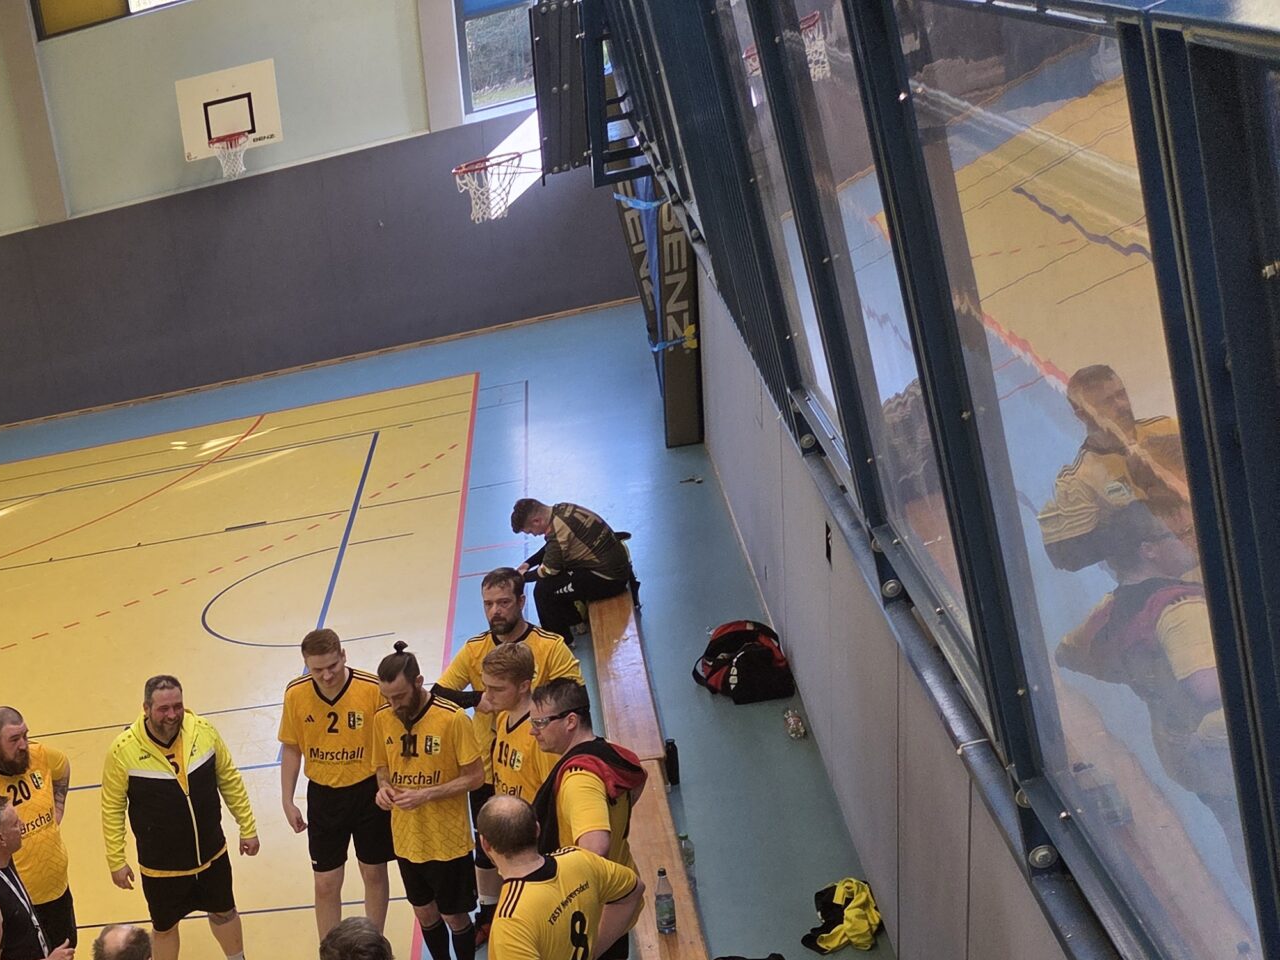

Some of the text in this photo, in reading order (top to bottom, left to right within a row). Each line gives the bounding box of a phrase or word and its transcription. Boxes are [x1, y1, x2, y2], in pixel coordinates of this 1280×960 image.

[327, 711, 339, 733] 2
[309, 746, 365, 761] Marschall
[497, 741, 510, 767] 19
[6, 780, 31, 807] 20
